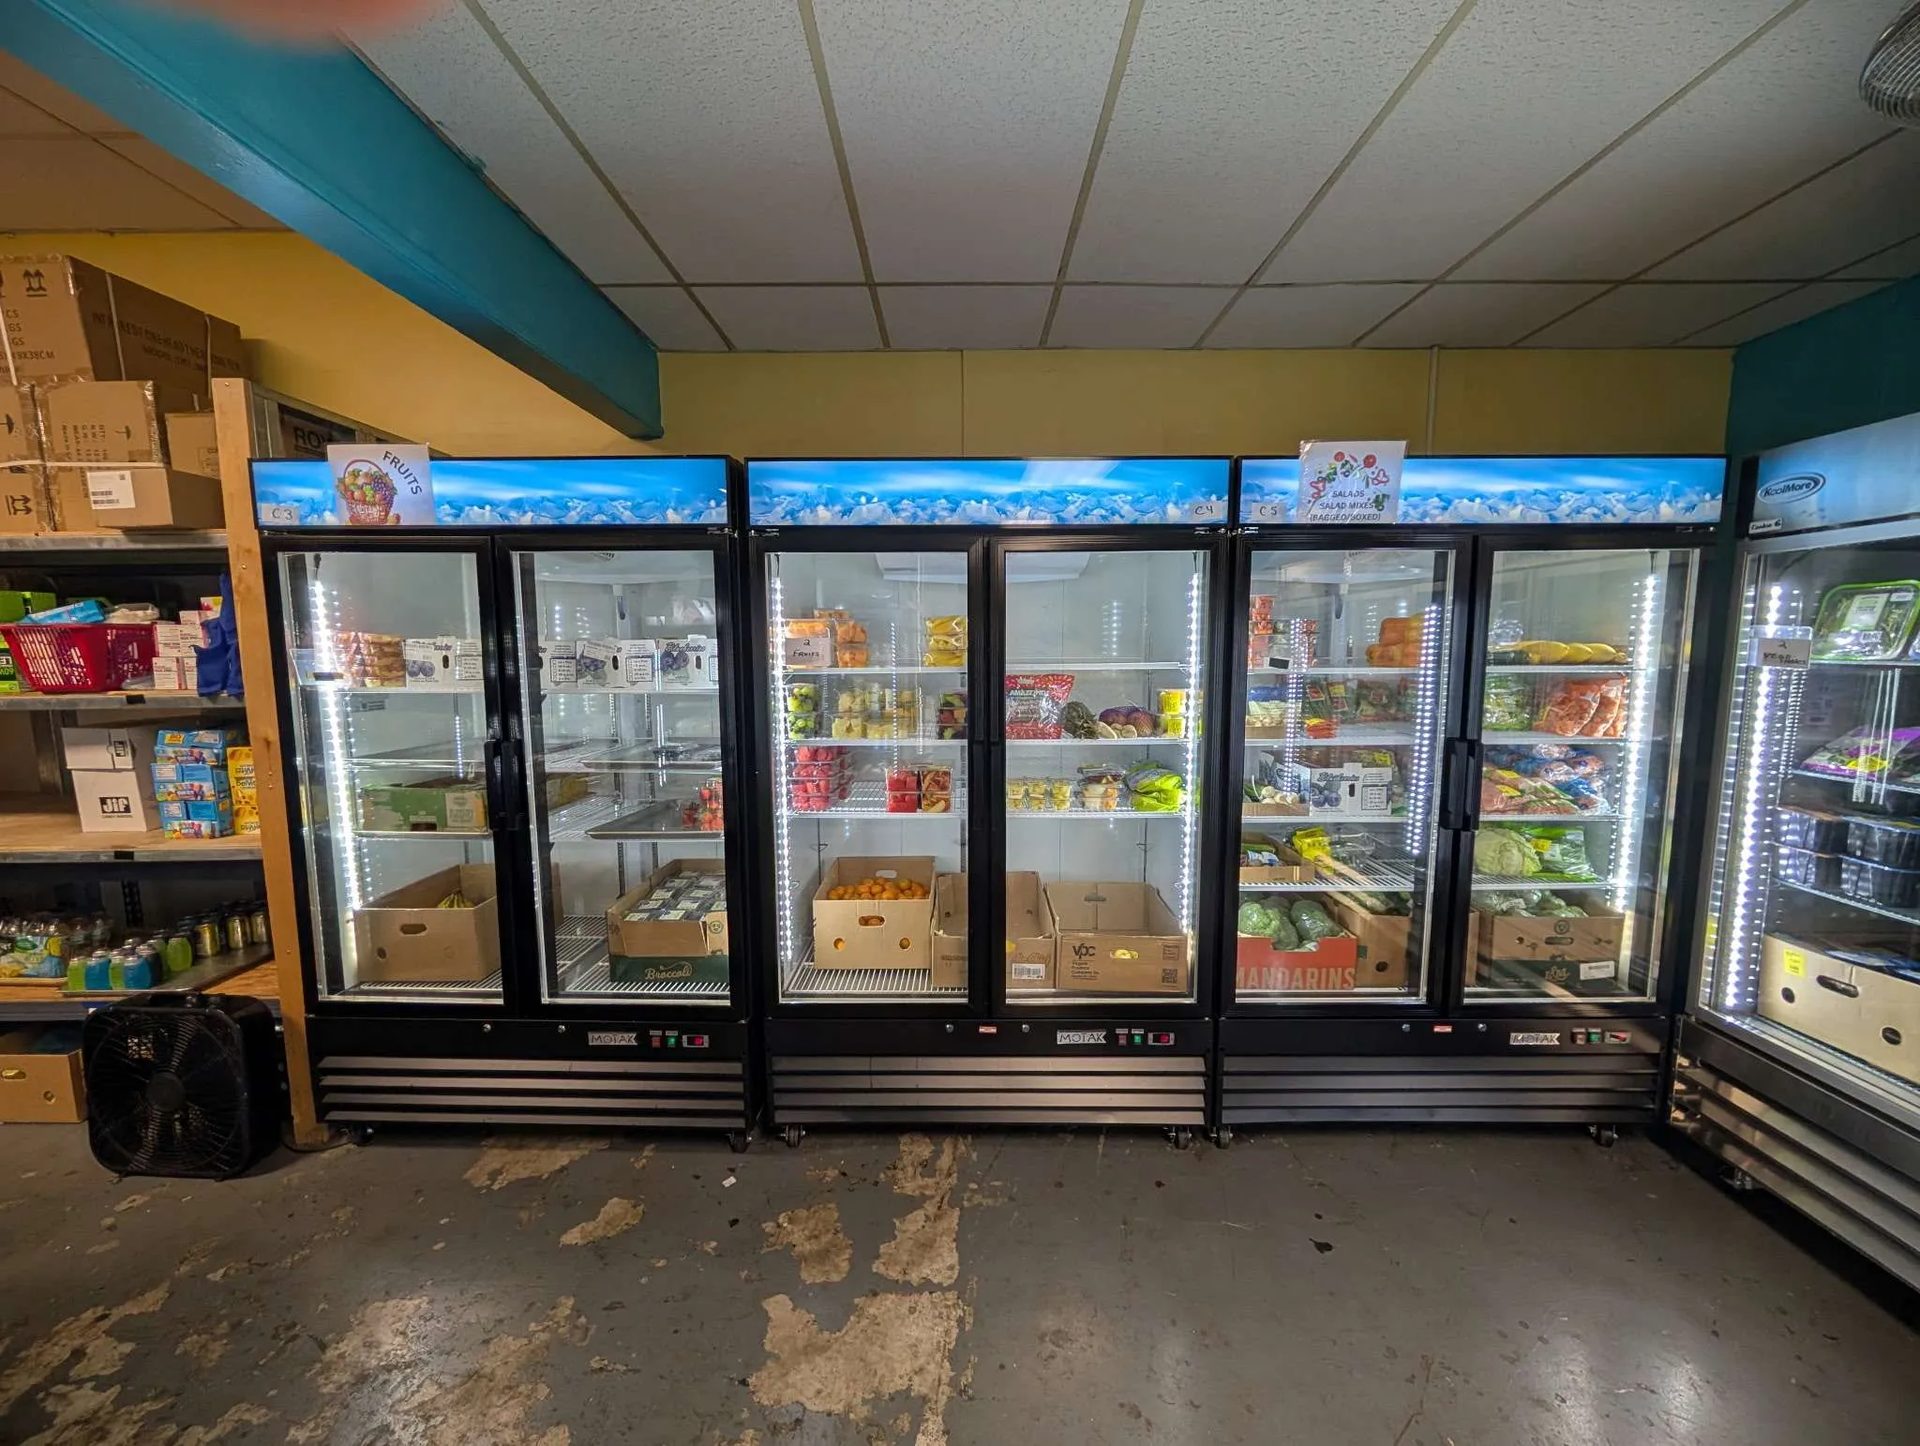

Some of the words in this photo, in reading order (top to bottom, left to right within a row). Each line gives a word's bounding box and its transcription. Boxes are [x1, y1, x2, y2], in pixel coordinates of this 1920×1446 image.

[382, 450, 423, 496] FRUITS
[1332, 490, 1365, 498] SALADS
[1763, 481, 1812, 498] KoolMore
[1319, 502, 1347, 510] SALAD
[1349, 501, 1374, 509] MIXES
[644, 961, 693, 980] Broccoli
[591, 1033, 635, 1045] MOTAK
[1059, 1032, 1104, 1043] MOTAK
[1513, 1034, 1556, 1044] MOTAK
